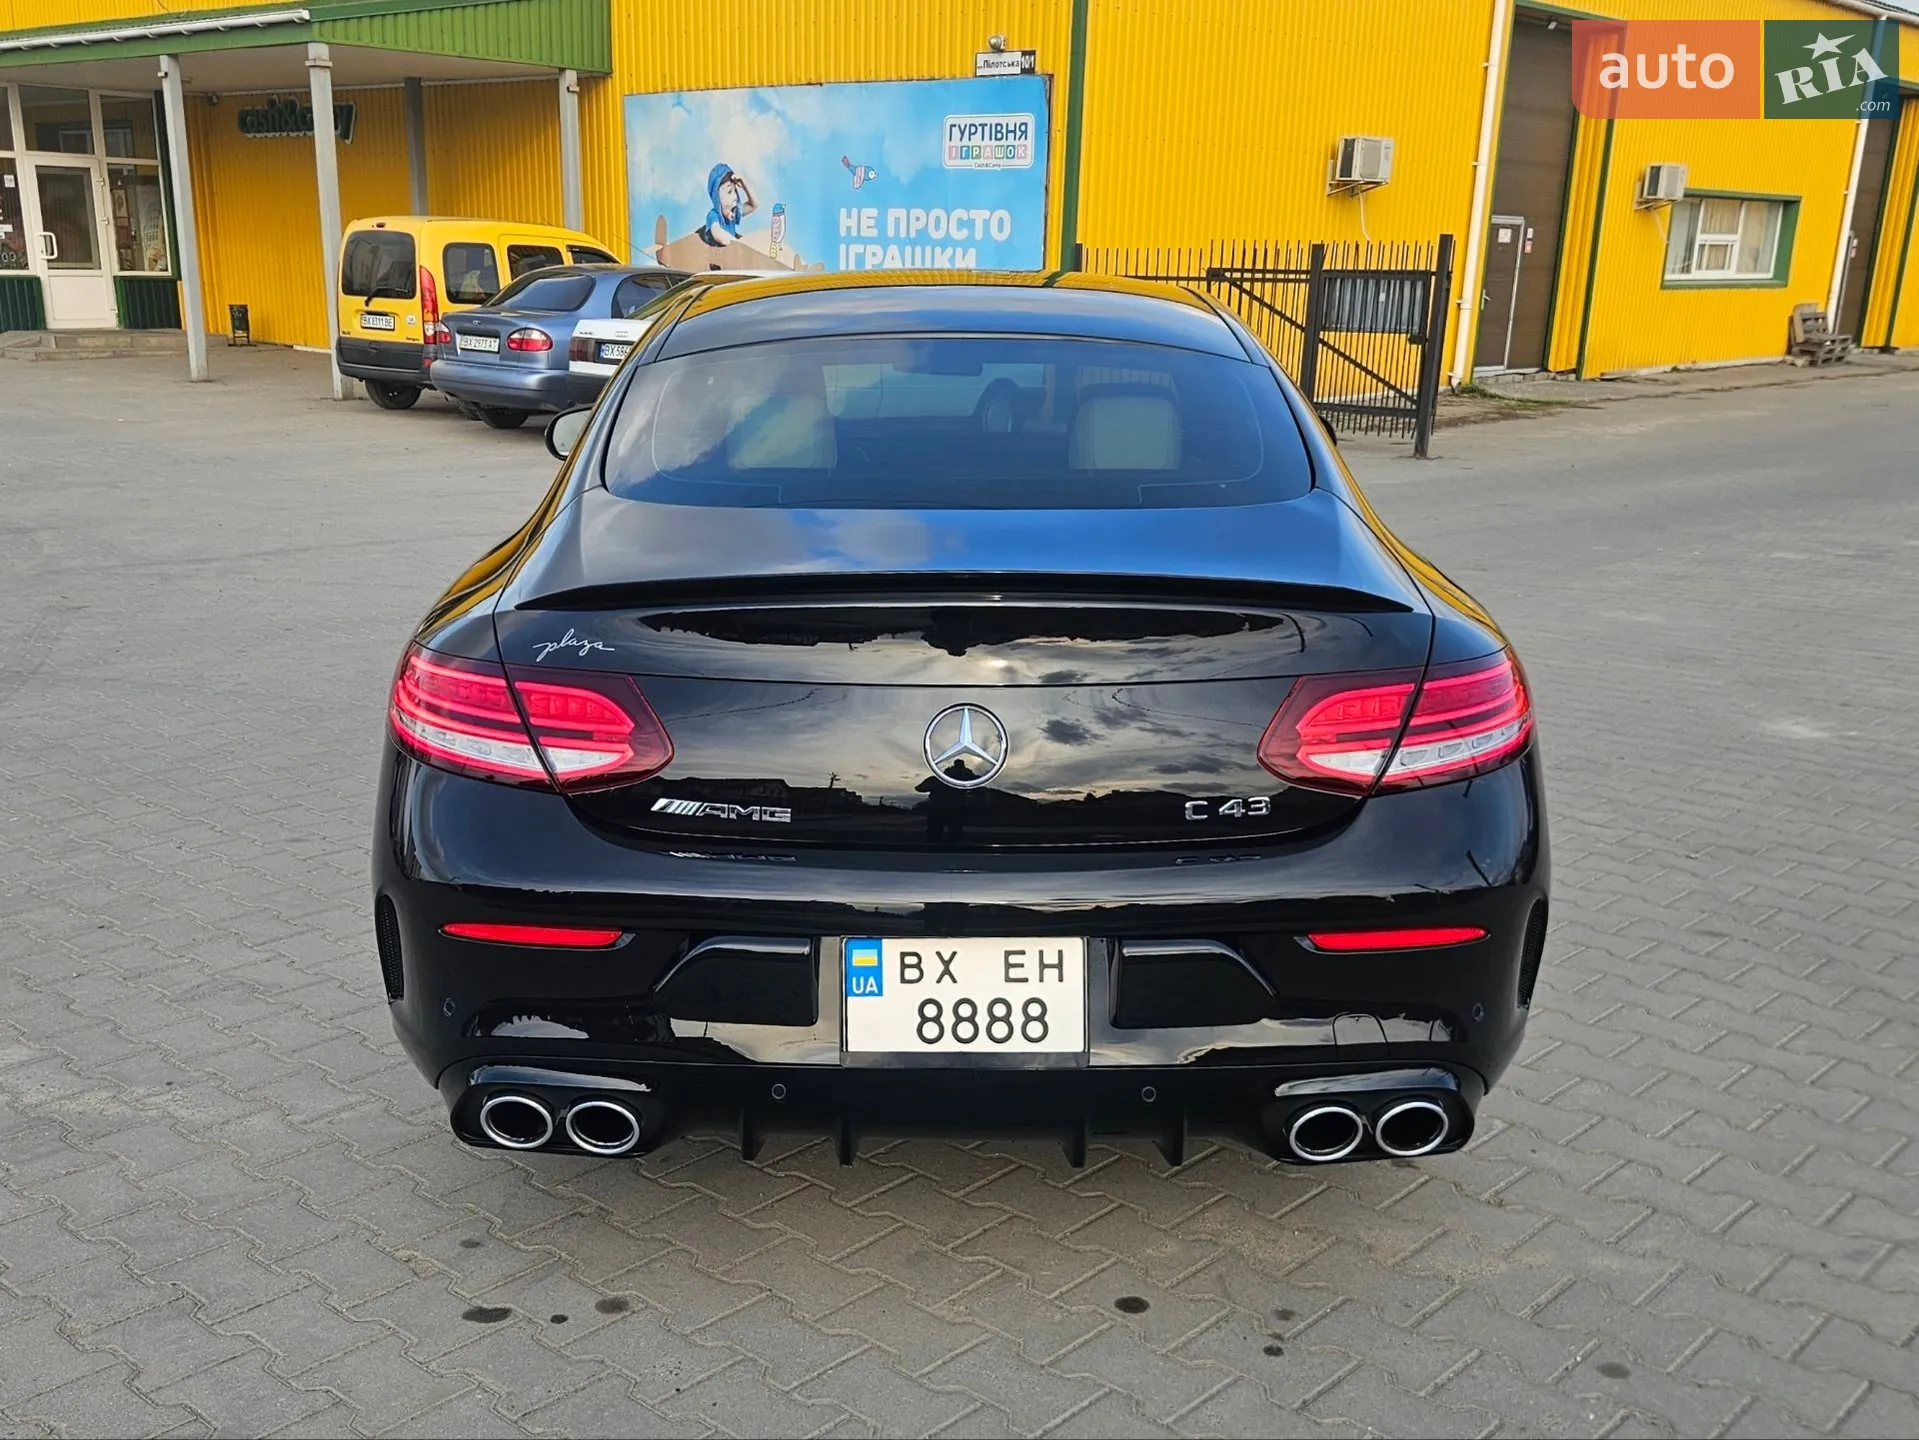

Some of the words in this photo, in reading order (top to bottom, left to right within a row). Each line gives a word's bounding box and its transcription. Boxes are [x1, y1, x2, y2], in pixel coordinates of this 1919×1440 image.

[983, 59, 1020, 69] Пілотська
[948, 122, 1029, 142] ГУРТІВНЯ
[950, 145, 1027, 159] ІГРАШОК
[839, 207, 879, 237] НЕ
[887, 208, 1012, 241] ПРОСТО
[839, 243, 977, 270] ІГРАШКИ
[533, 628, 615, 662] plaza
[697, 802, 792, 823] AMG
[1184, 800, 1208, 820] C
[1218, 796, 1272, 817] 43
[899, 951, 958, 984] BX
[1003, 949, 1064, 983] EH
[852, 976, 879, 995] UA
[916, 997, 1049, 1045] 8888
